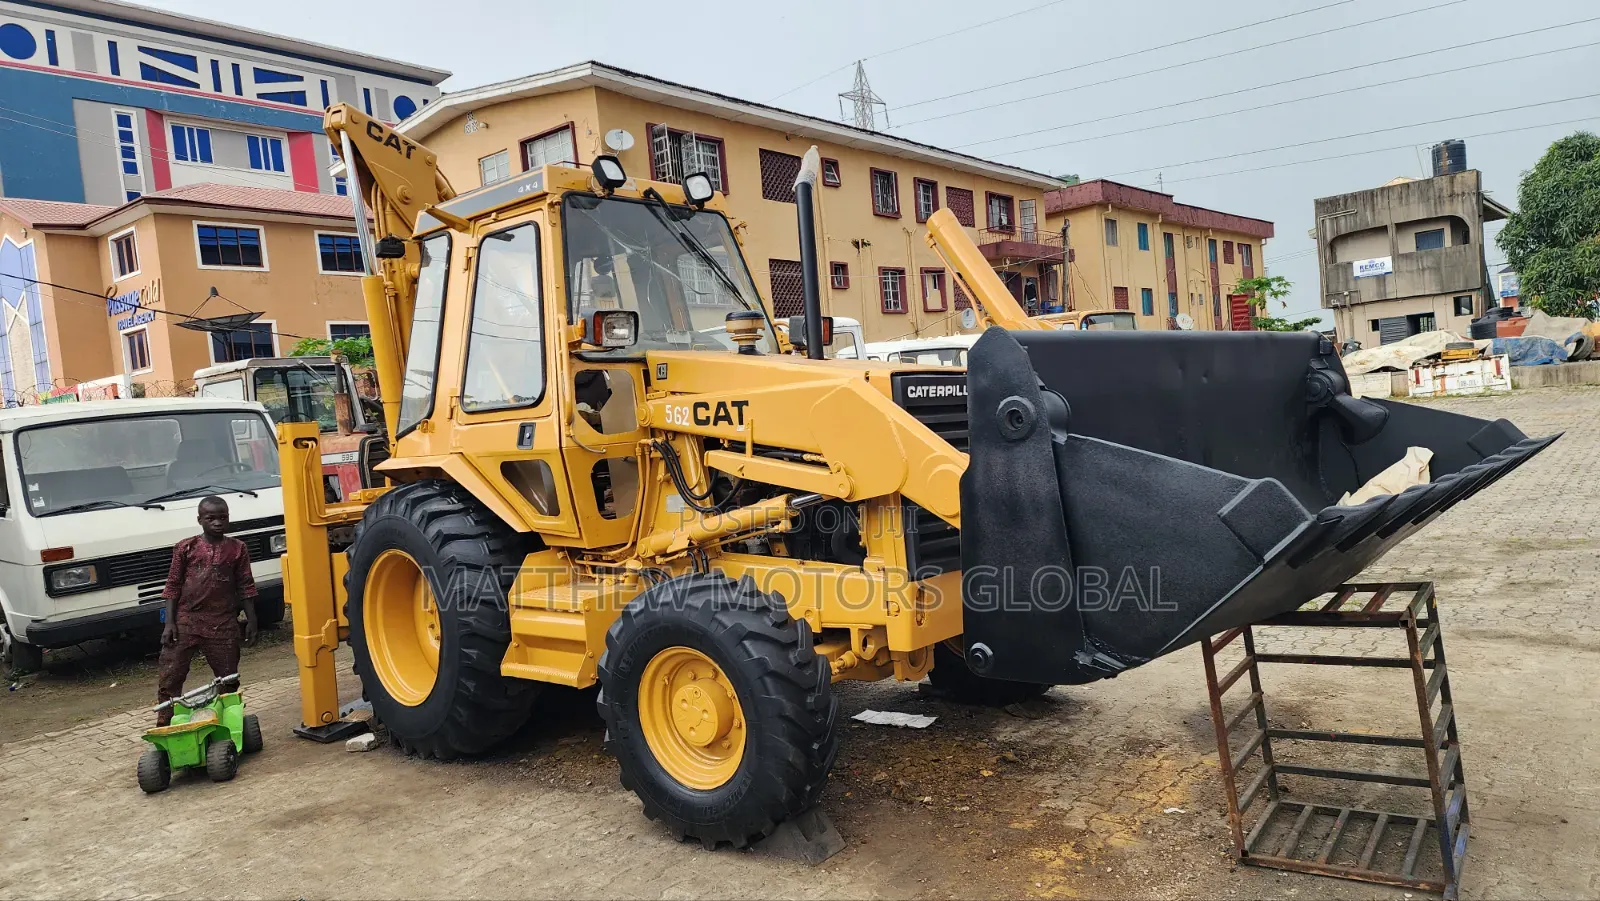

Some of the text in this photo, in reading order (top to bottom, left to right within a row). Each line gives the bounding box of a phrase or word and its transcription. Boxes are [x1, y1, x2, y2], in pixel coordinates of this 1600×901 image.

[366, 120, 417, 160] CAT
[665, 400, 749, 426] 562 CAT
